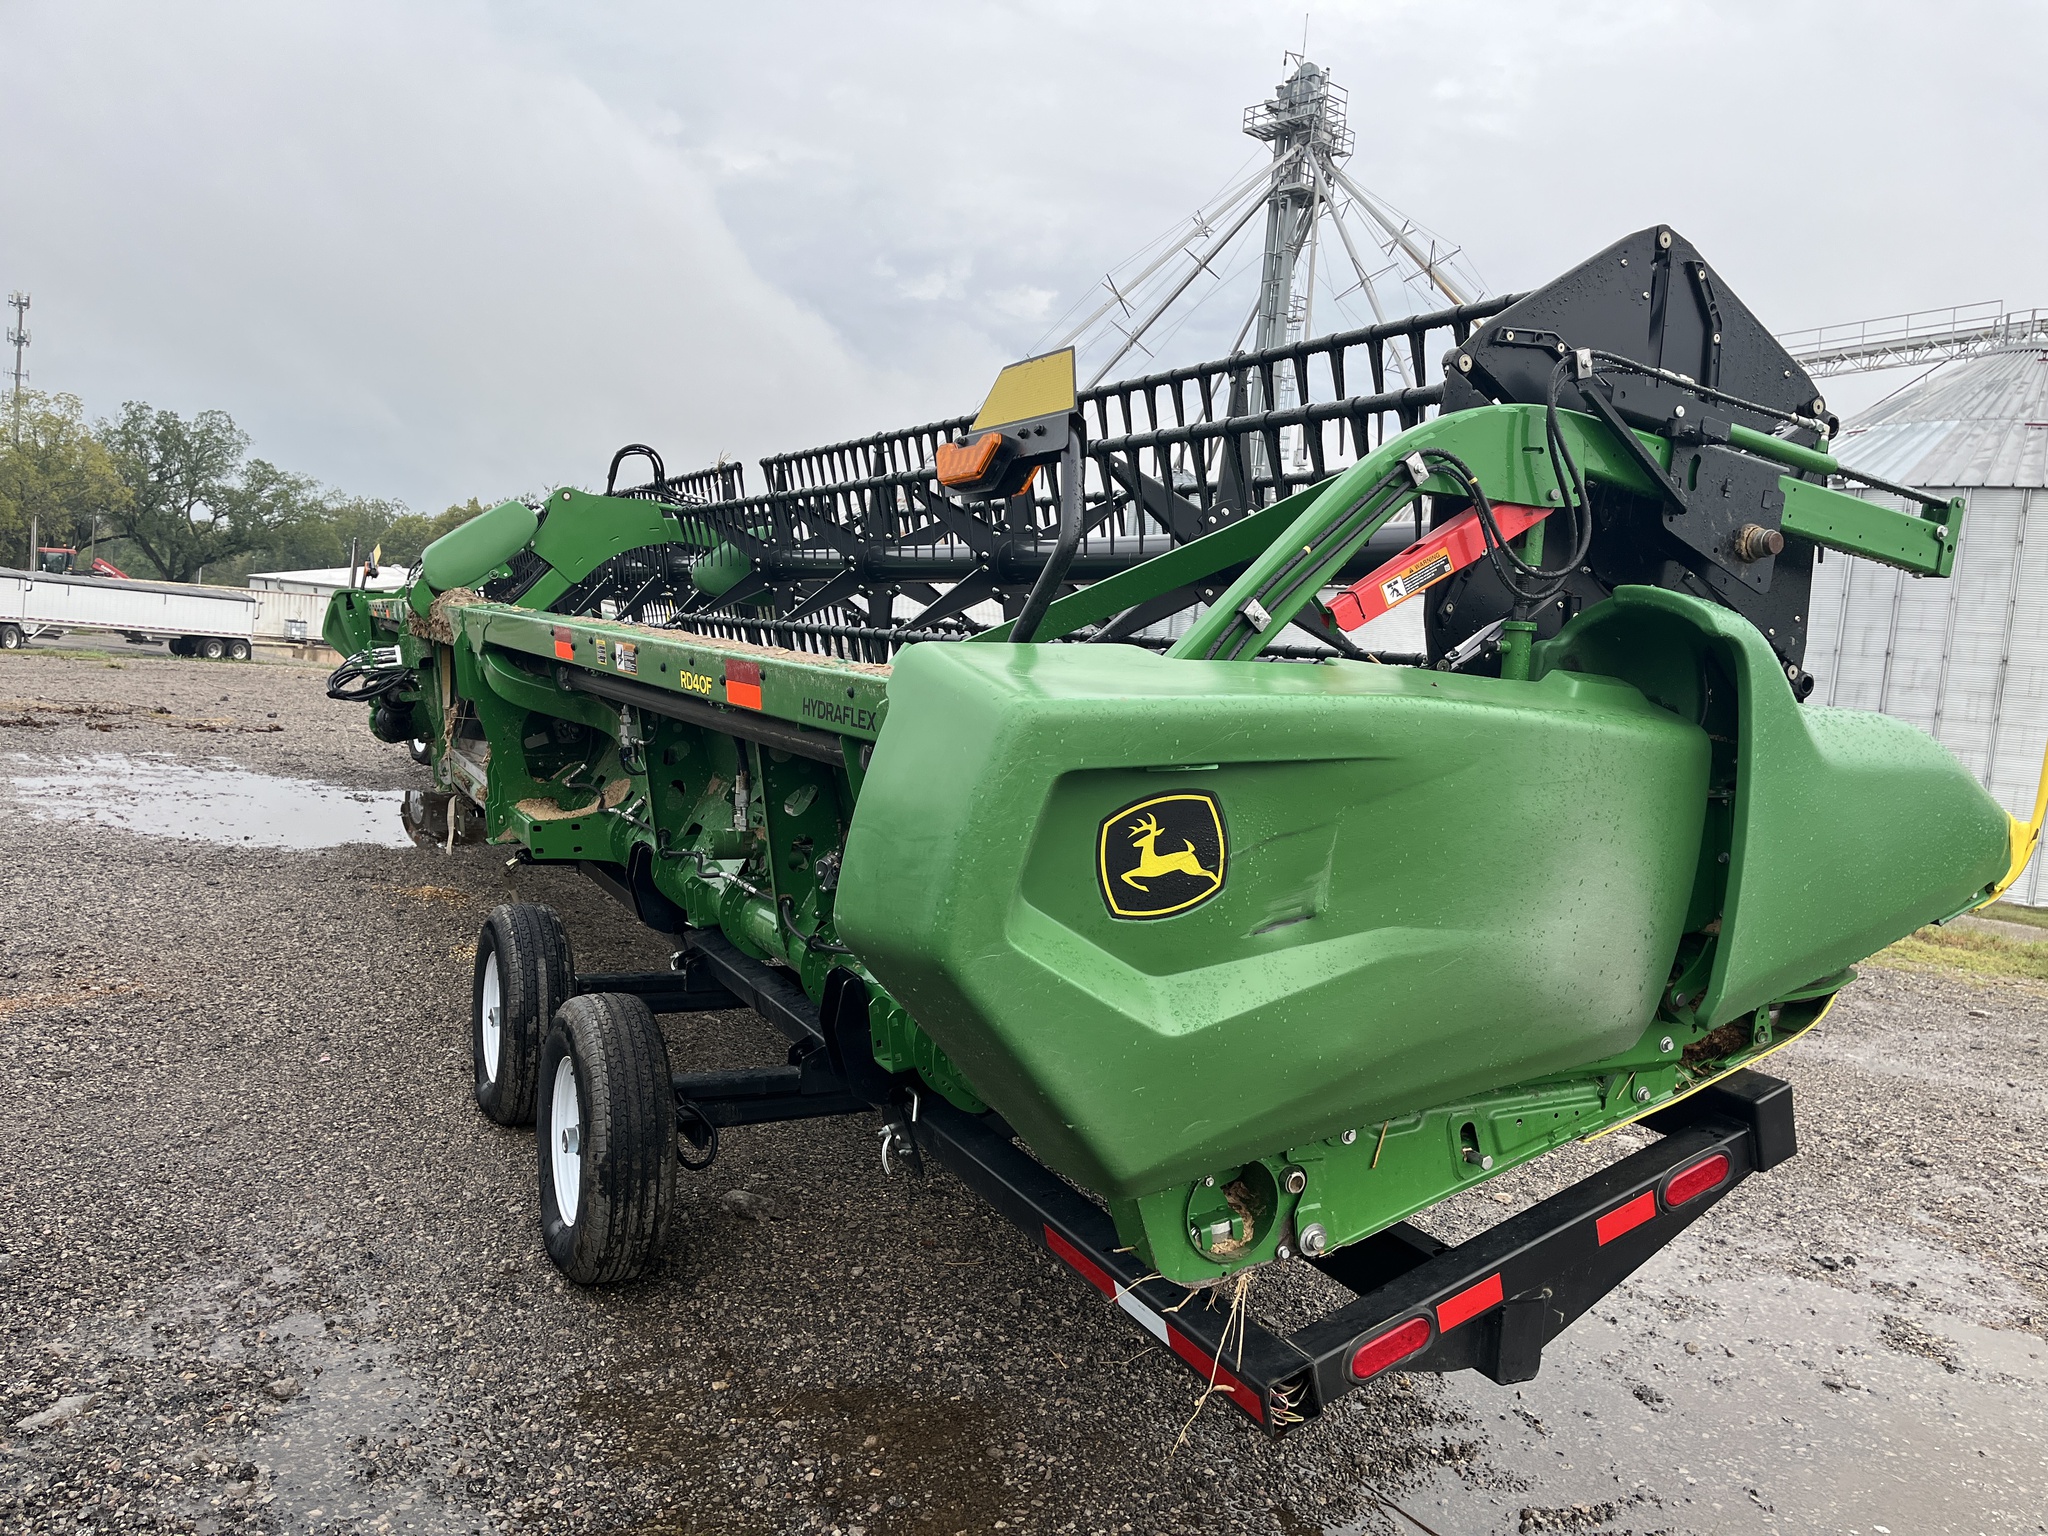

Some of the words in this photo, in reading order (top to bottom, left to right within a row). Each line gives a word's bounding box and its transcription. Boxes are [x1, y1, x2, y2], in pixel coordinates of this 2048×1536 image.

[1415, 552, 1441, 569] WARNING
[680, 669, 712, 695] RD40F
[803, 697, 876, 732] HYDRAFLEX
